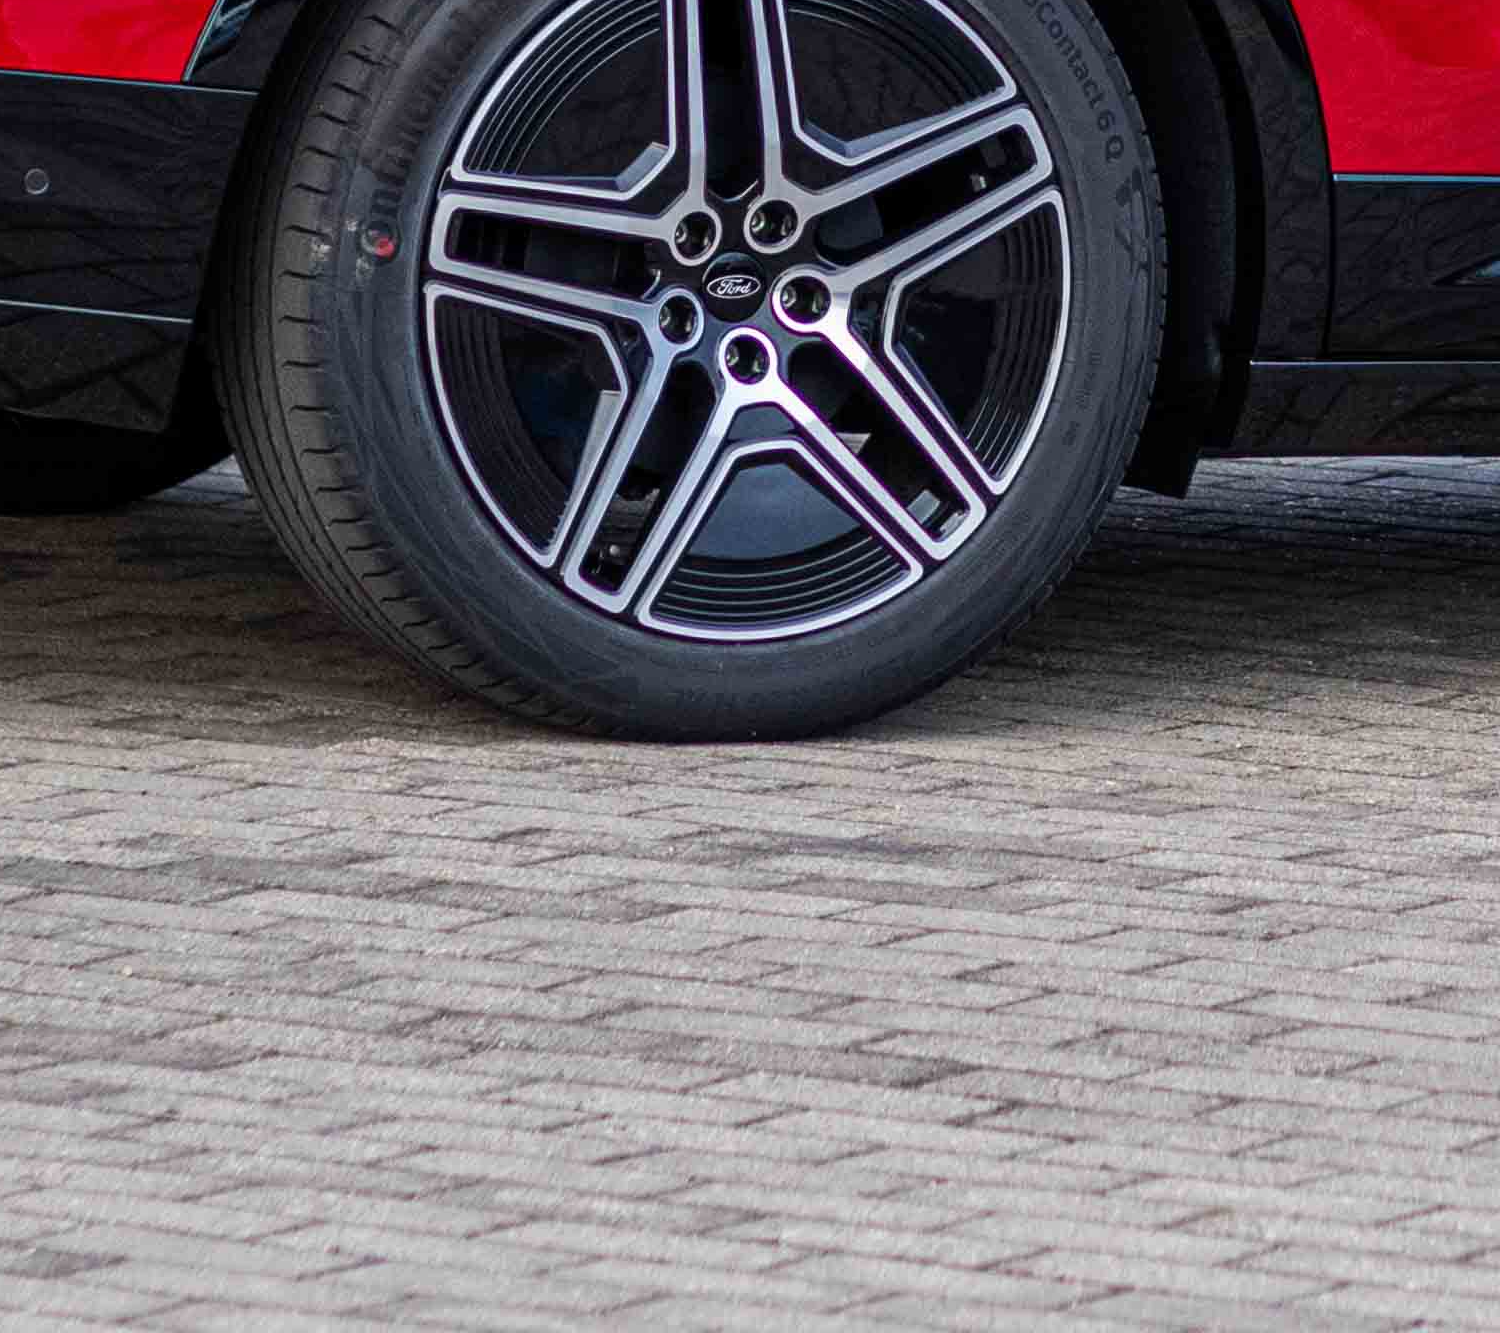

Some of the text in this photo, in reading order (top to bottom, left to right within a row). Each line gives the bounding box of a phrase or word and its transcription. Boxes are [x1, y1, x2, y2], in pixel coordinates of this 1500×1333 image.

[1097, 110, 1116, 131] 6
[1104, 137, 1126, 164] Q
[716, 277, 753, 295] Ford
